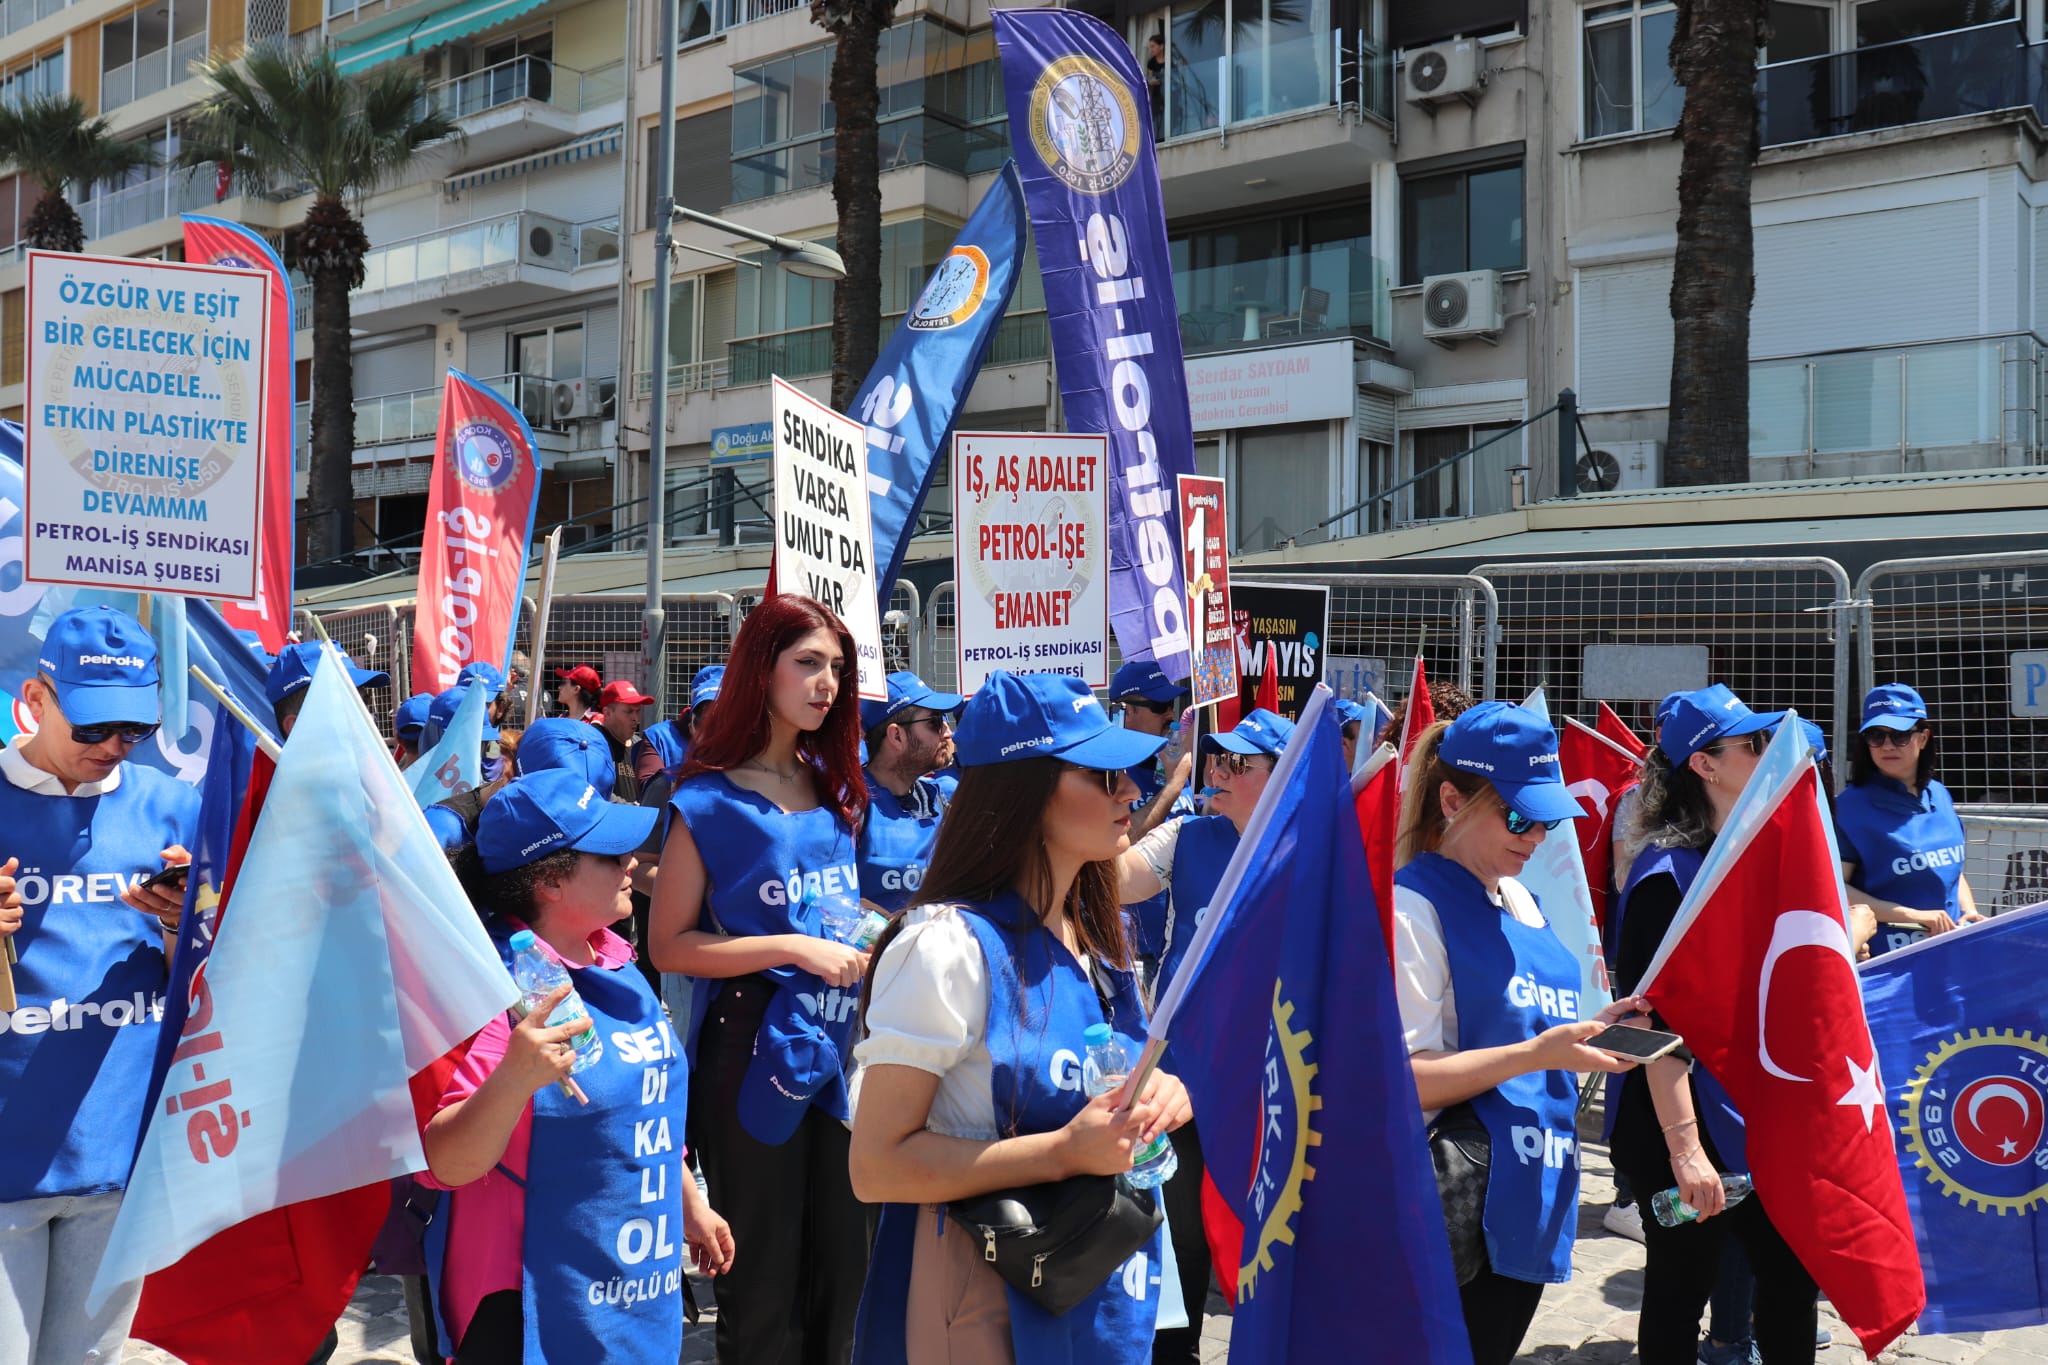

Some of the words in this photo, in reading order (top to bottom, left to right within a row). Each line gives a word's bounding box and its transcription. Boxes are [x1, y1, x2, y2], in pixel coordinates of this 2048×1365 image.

[59, 273, 150, 311] ÖZGÜR
[157, 288, 186, 314] VE
[193, 287, 240, 324] EŞİT
[44, 315, 84, 346] BİR
[93, 325, 195, 357] GELECEK
[202, 328, 250, 366] İÇİN
[73, 360, 222, 401] MÜCADELE...
[1247, 356, 1311, 380] SAYDAM
[44, 401, 115, 432] ETKİN
[124, 410, 248, 444] PLASTİK'TE
[732, 432, 758, 447] Doğu
[783, 408, 857, 478] SENDİKA
[93, 445, 200, 485] DİRENİŞE
[966, 444, 989, 503] İŞ,
[995, 455, 1019, 503] AŞ
[1026, 455, 1097, 492] ADALET
[83, 489, 208, 522] DEVAMMM
[793, 464, 850, 522] VARSA
[36, 522, 139, 549] PETROL-İŞ
[145, 530, 249, 556] SENDİKASI
[783, 511, 833, 564] UMUT
[840, 535, 867, 575] DA
[979, 513, 1085, 570] PETROL-İŞE
[65, 554, 148, 577] MANİSA
[154, 562, 221, 583] ŞUBESİ
[808, 571, 845, 617] VAR
[995, 590, 1073, 630] EMANET
[1252, 617, 1297, 640] YAŞASIN
[80, 654, 145, 669] petrol-iş
[964, 641, 1031, 662] PETROL-İŞ
[1034, 639, 1102, 657] SENDİKASI
[1236, 640, 1316, 678] MYIS
[1000, 735, 1054, 757] petrol-iş
[520, 831, 564, 857] petrol-iş
[641, 1066, 668, 1106] Dİ
[634, 1116, 672, 1158] KA
[1925, 1088, 1961, 1169] 1952
[640, 1164, 666, 1204] LI
[616, 1214, 674, 1265] OL
[588, 1271, 661, 1309] GÜÇLÜ
